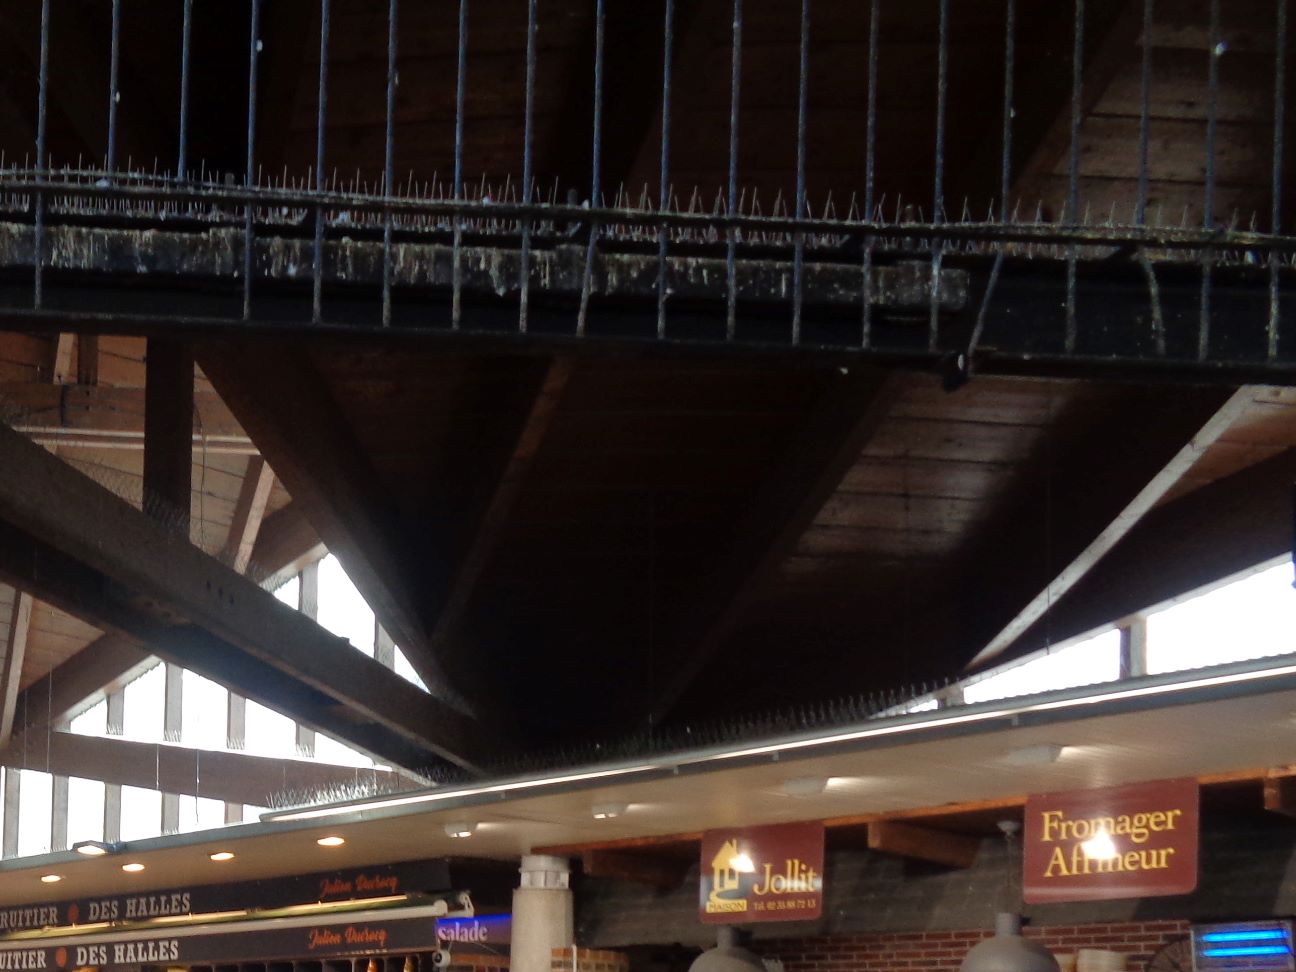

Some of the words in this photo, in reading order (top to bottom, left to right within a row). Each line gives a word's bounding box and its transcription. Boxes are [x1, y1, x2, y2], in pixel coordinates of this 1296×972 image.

[1041, 809, 1182, 843] Fromager
[752, 859, 817, 895] Jollit
[88, 900, 119, 921] DES
[126, 892, 191, 918] HALLES
[438, 920, 488, 942] salade
[76, 944, 108, 966] DES
[114, 939, 179, 964] HALLES
